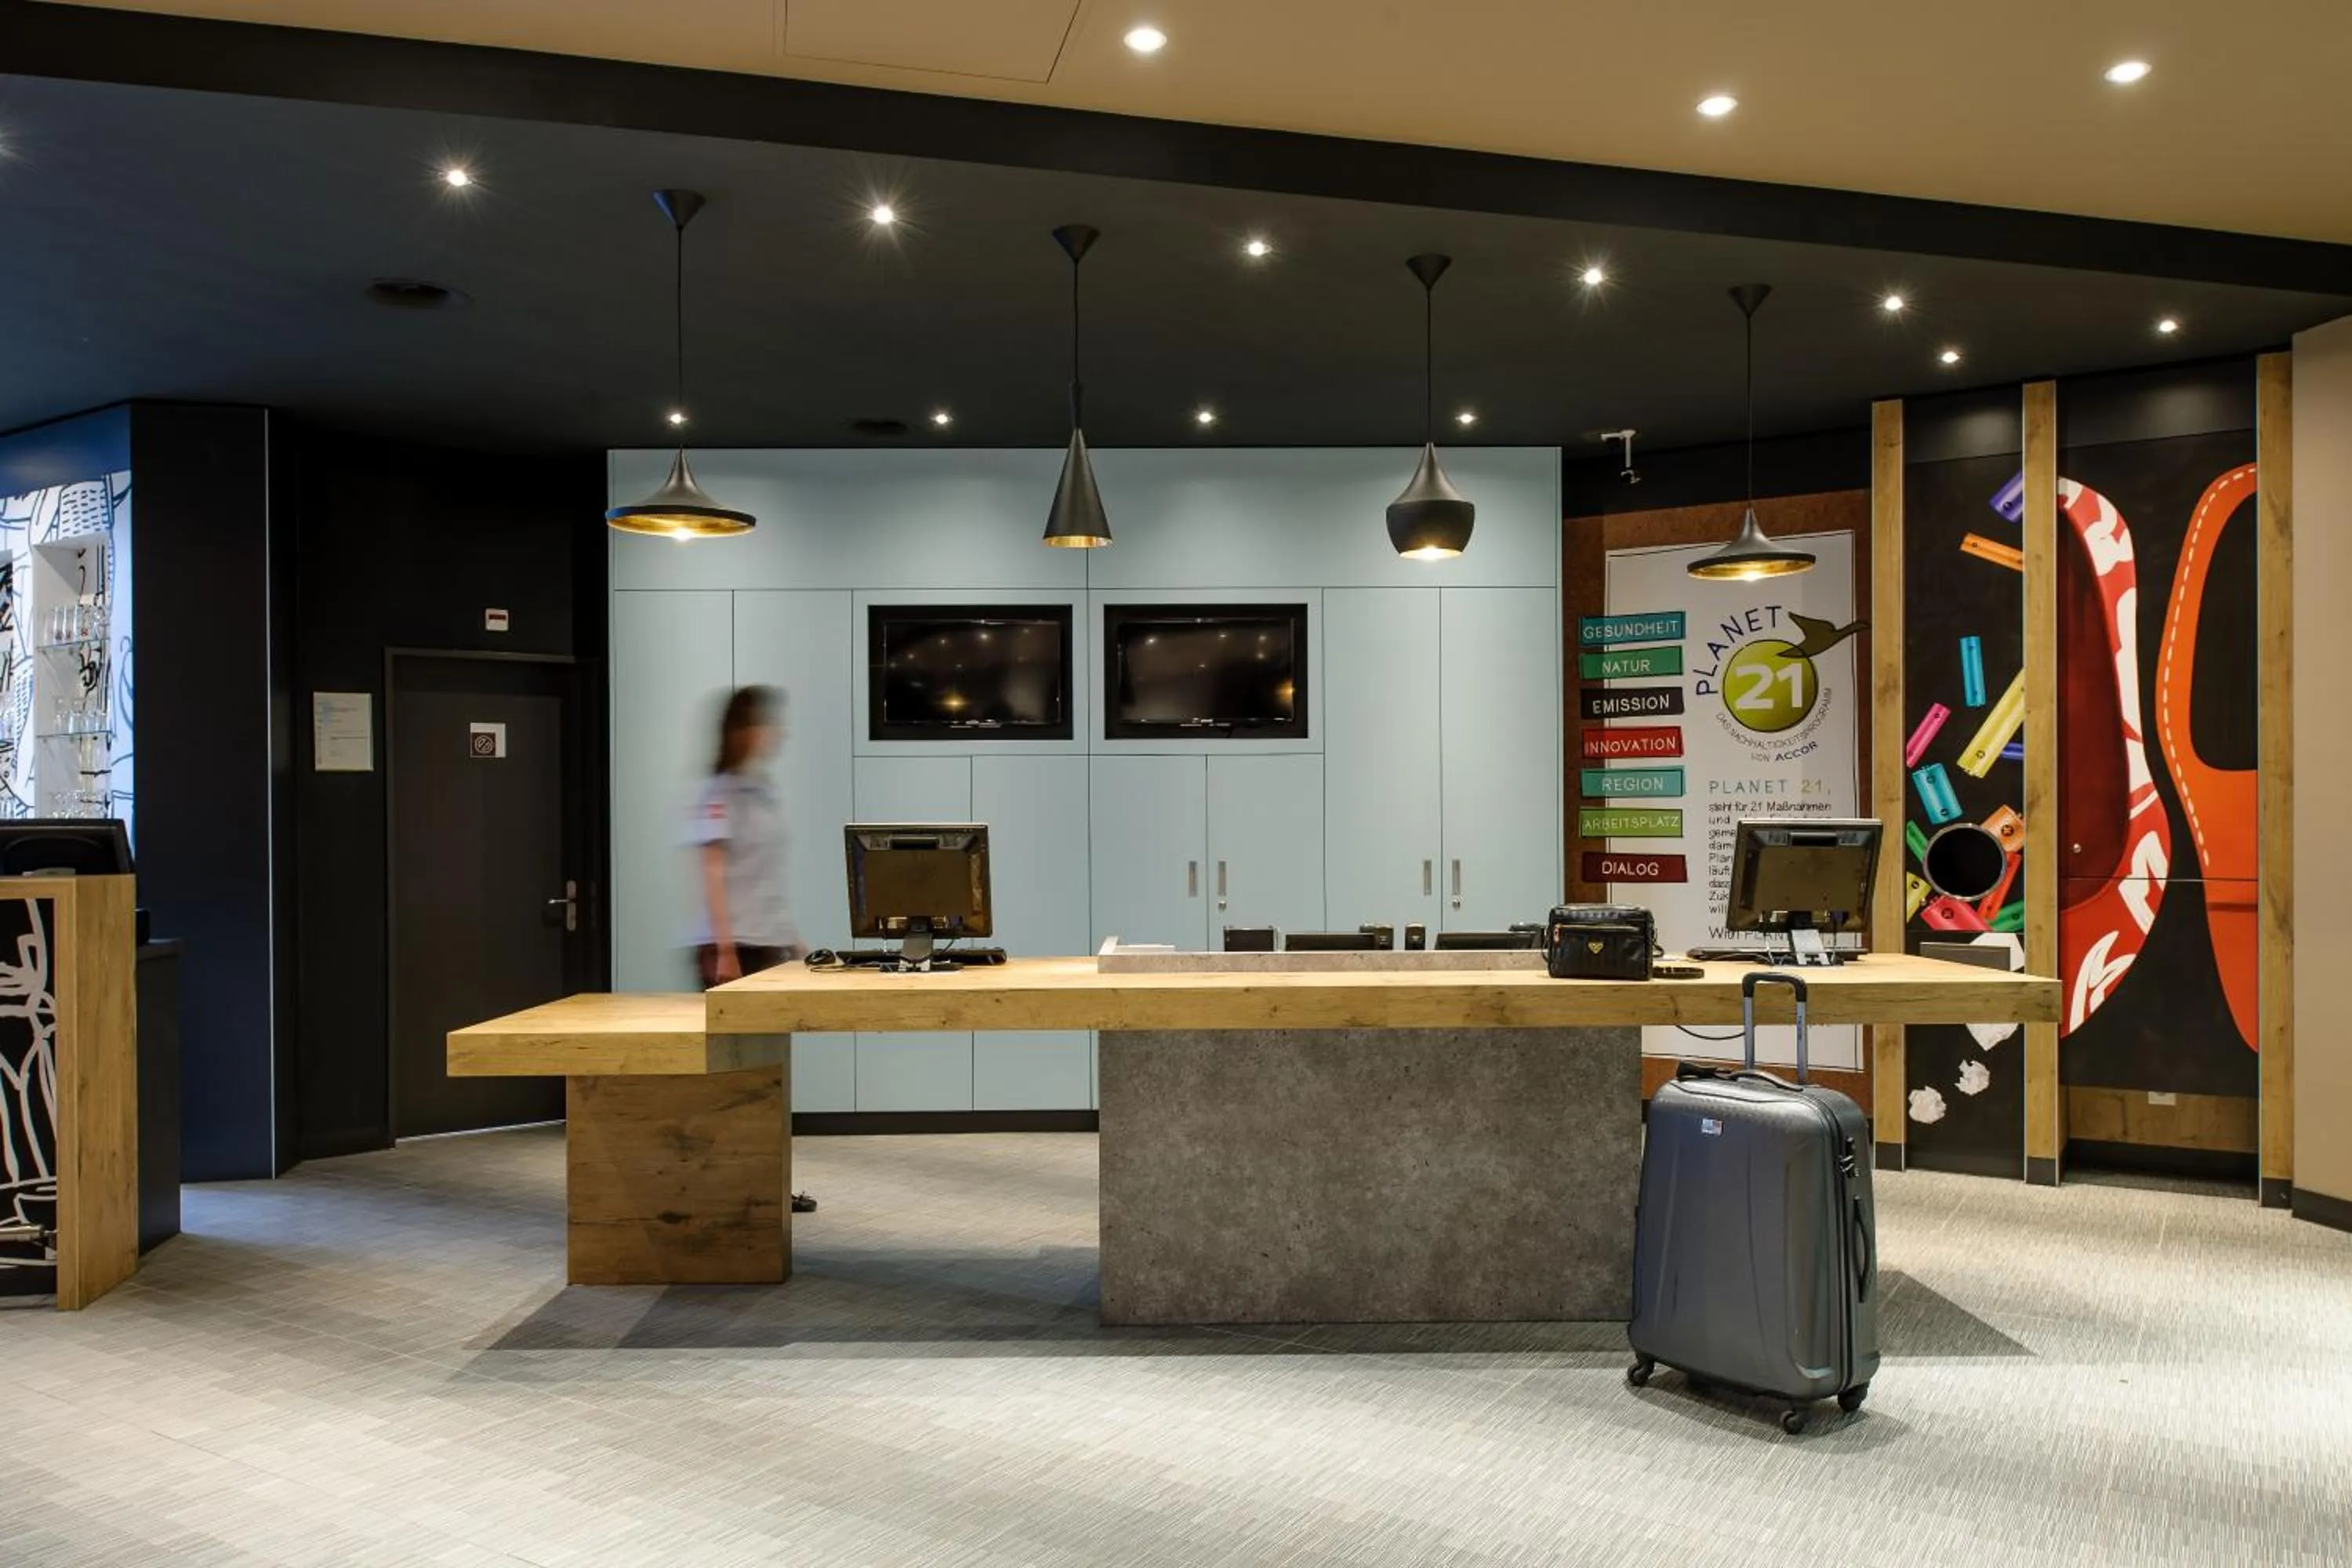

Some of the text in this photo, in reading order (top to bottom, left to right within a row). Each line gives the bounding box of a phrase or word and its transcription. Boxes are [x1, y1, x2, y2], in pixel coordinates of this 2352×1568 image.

[1582, 619, 1679, 640] GESUNDHEIT
[1693, 606, 1782, 695] PLANET
[1602, 659, 1651, 674] NATUR
[1735, 662, 1803, 710] 21
[1592, 693, 1670, 714] EMISSION
[1584, 736, 1676, 755] INNOVATION
[1775, 741, 1818, 763] ACCOR
[1601, 776, 1664, 792] REGION
[1708, 779, 1788, 794] PLANET
[1751, 801, 1762, 811] 21
[1766, 800, 1831, 812] Maßnahmen
[1583, 815, 1680, 831] ARBEITSPLATZ
[1708, 815, 1730, 824] und
[1708, 829, 1737, 840] geme
[1708, 852, 1733, 863] Plan
[1601, 860, 1660, 877] DIALOG
[1708, 891, 1729, 901] Zuk
